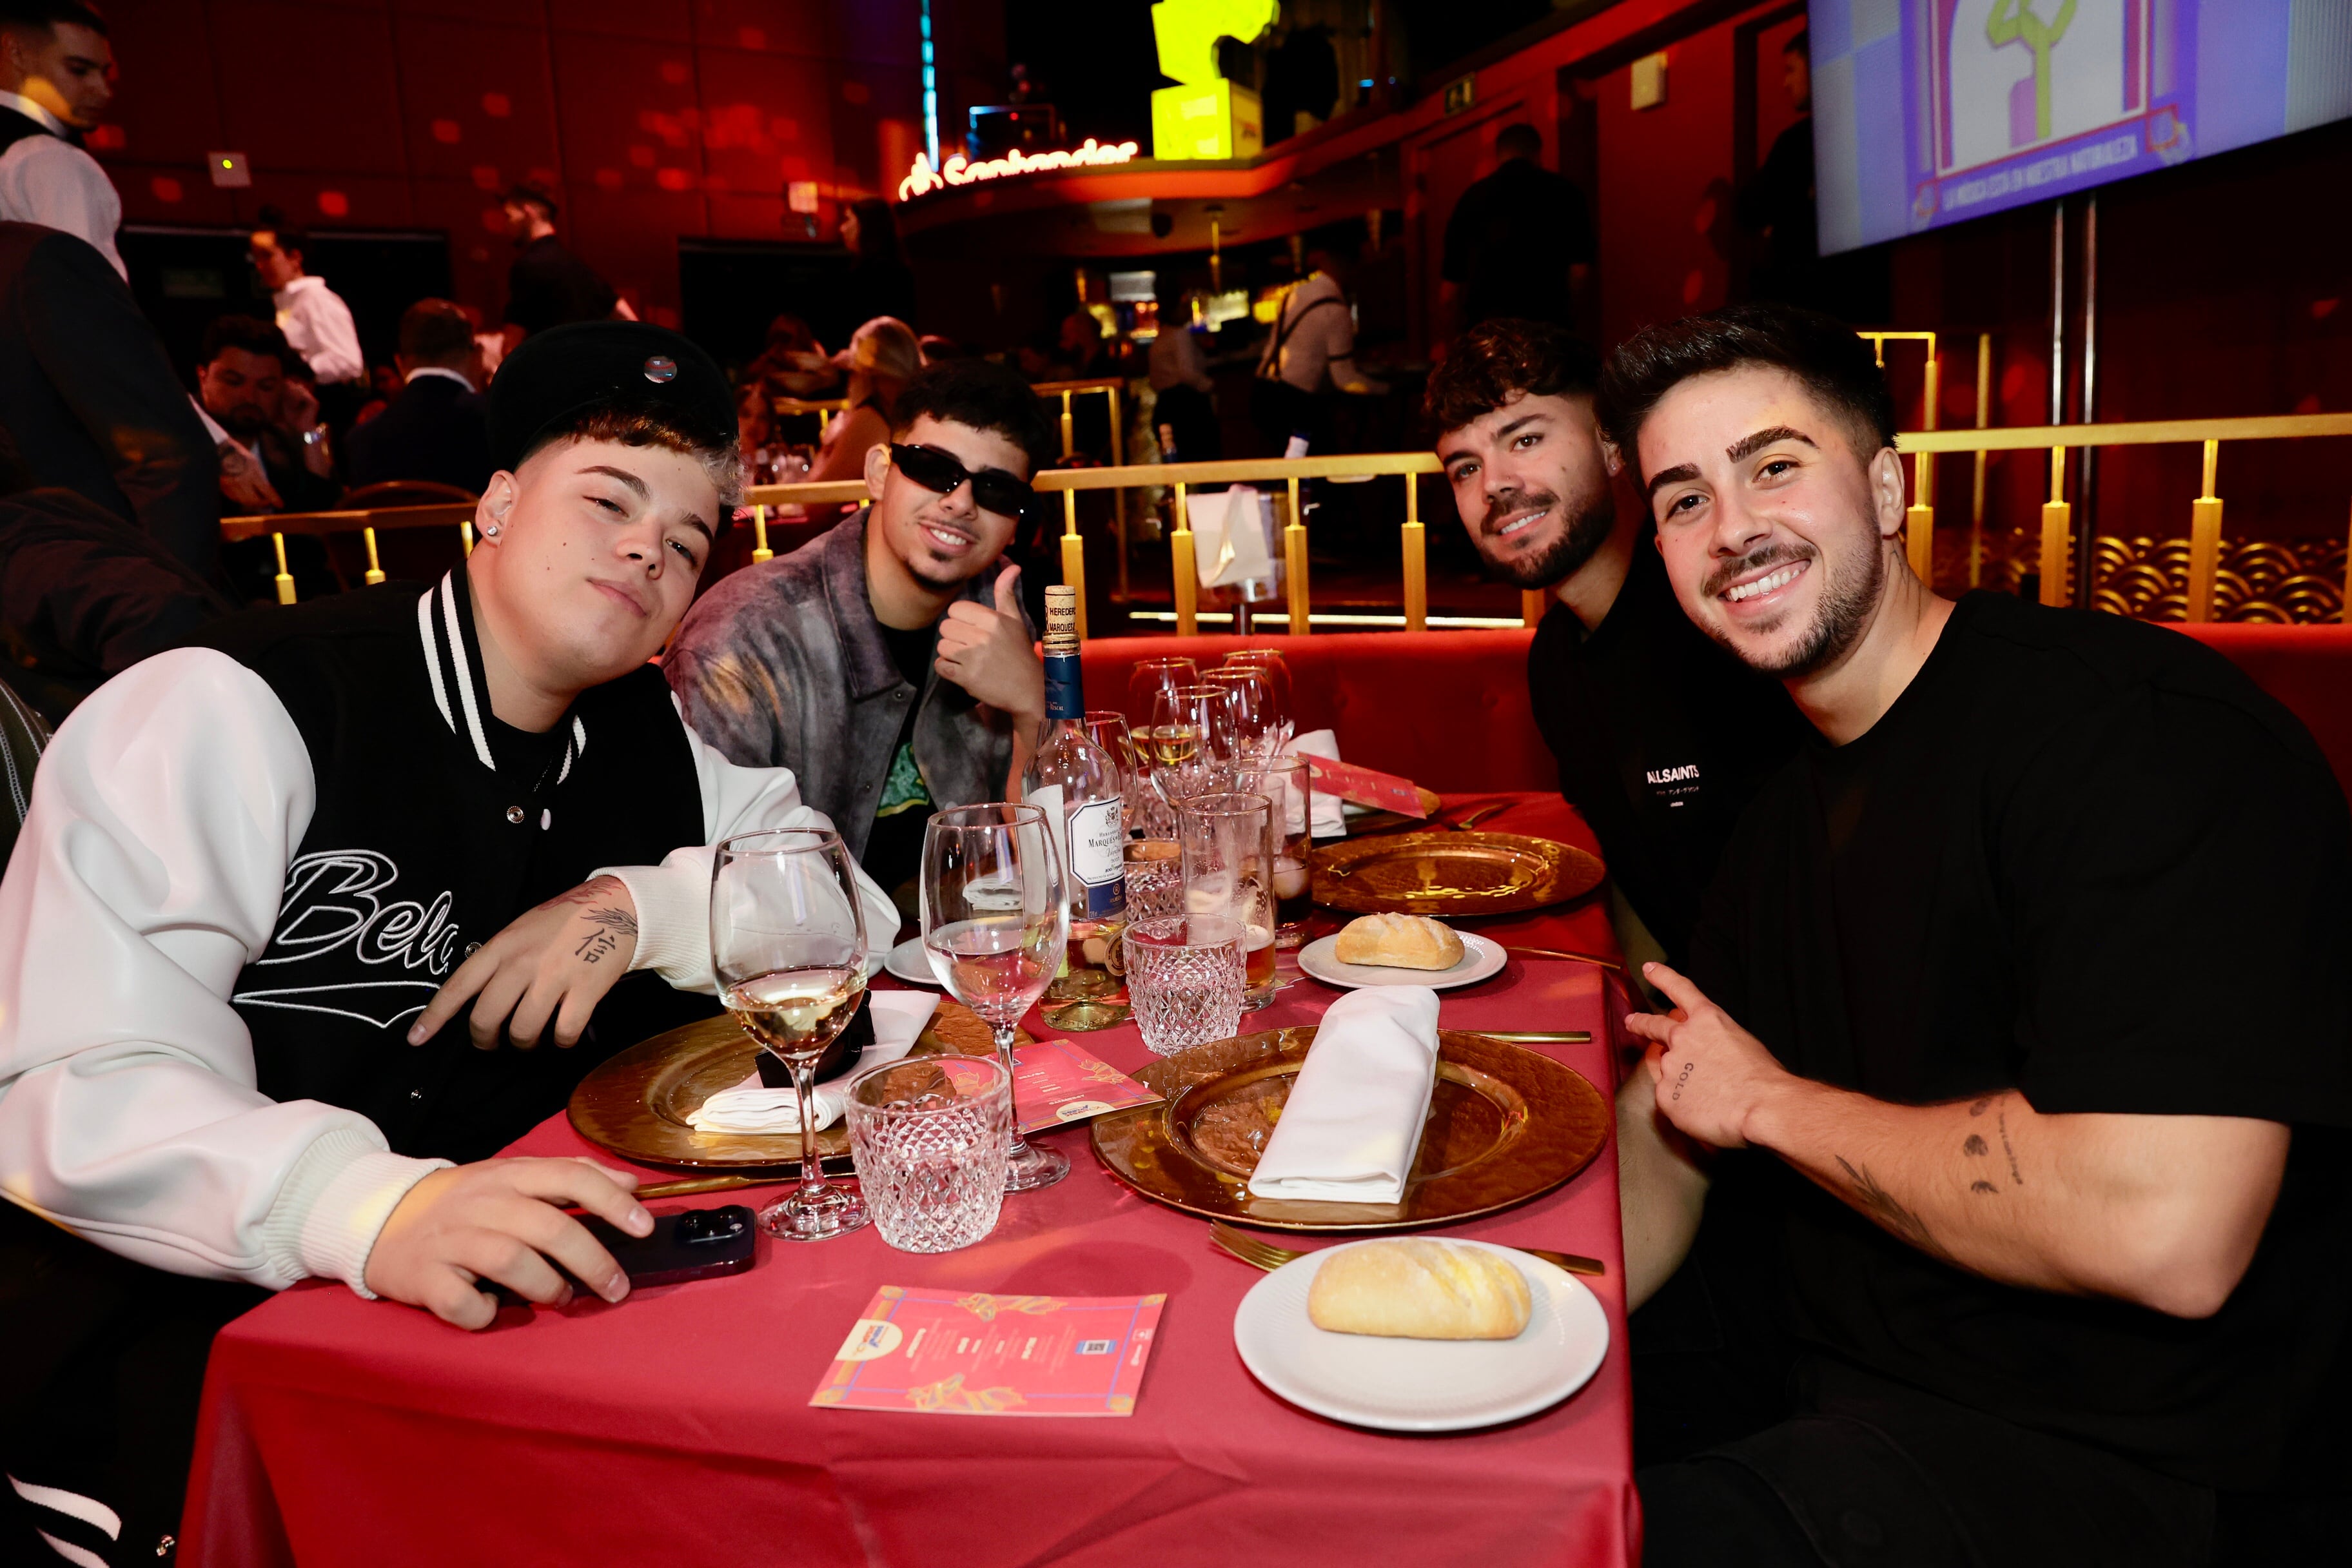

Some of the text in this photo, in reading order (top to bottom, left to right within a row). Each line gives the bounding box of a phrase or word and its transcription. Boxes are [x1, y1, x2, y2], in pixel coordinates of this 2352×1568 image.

[1088, 836, 1115, 848] MARQUÉS
[575, 927, 616, 964] 信
[1672, 1063, 1694, 1101] GOLD
